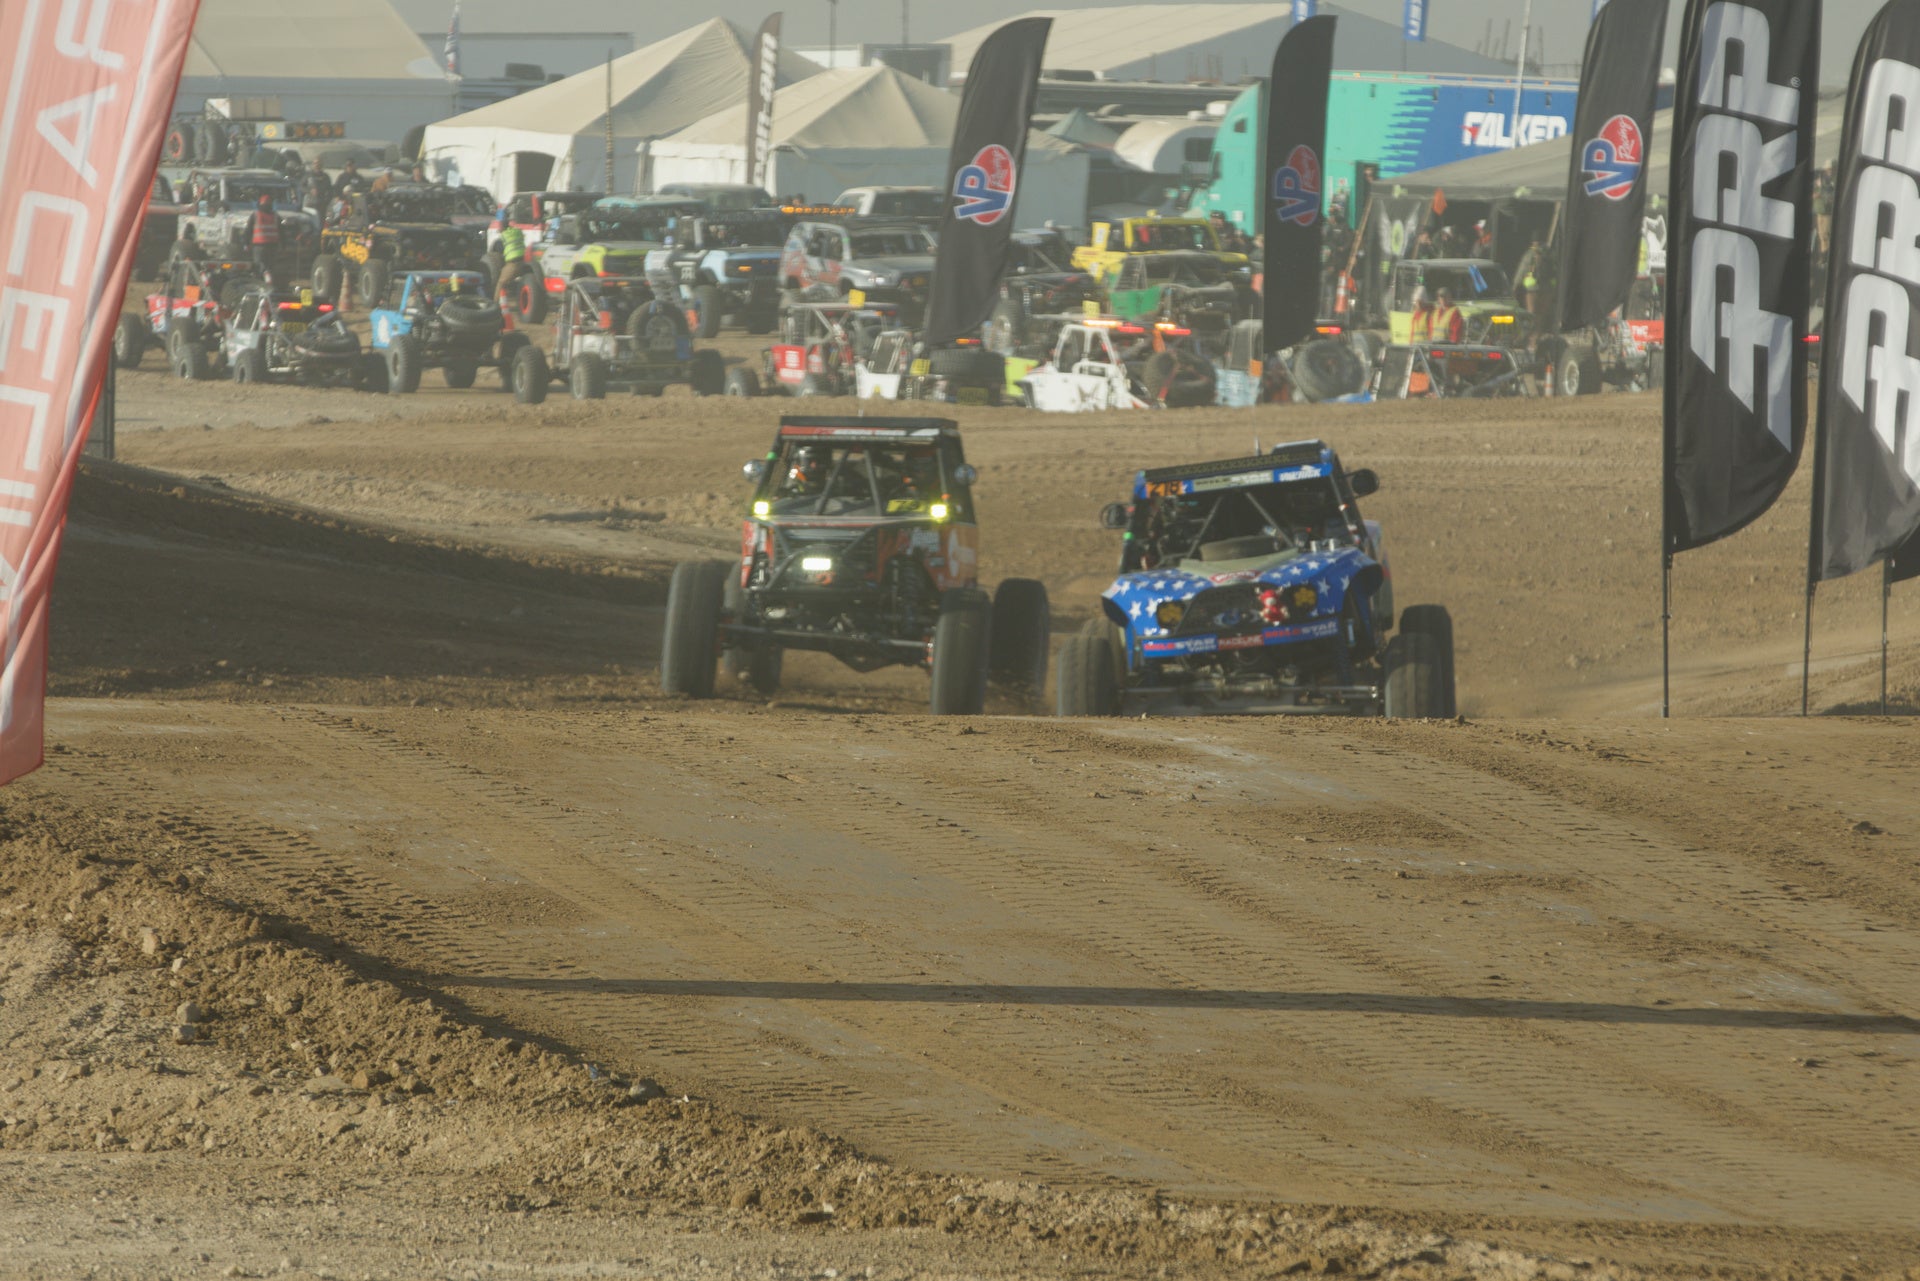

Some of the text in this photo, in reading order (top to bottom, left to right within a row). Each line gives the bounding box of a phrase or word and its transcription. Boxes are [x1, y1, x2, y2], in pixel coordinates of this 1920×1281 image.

[953, 165, 1011, 220] VP
[1273, 166, 1320, 222] VP
[1581, 138, 1641, 196] VP
[1690, 1, 1799, 453] PRP
